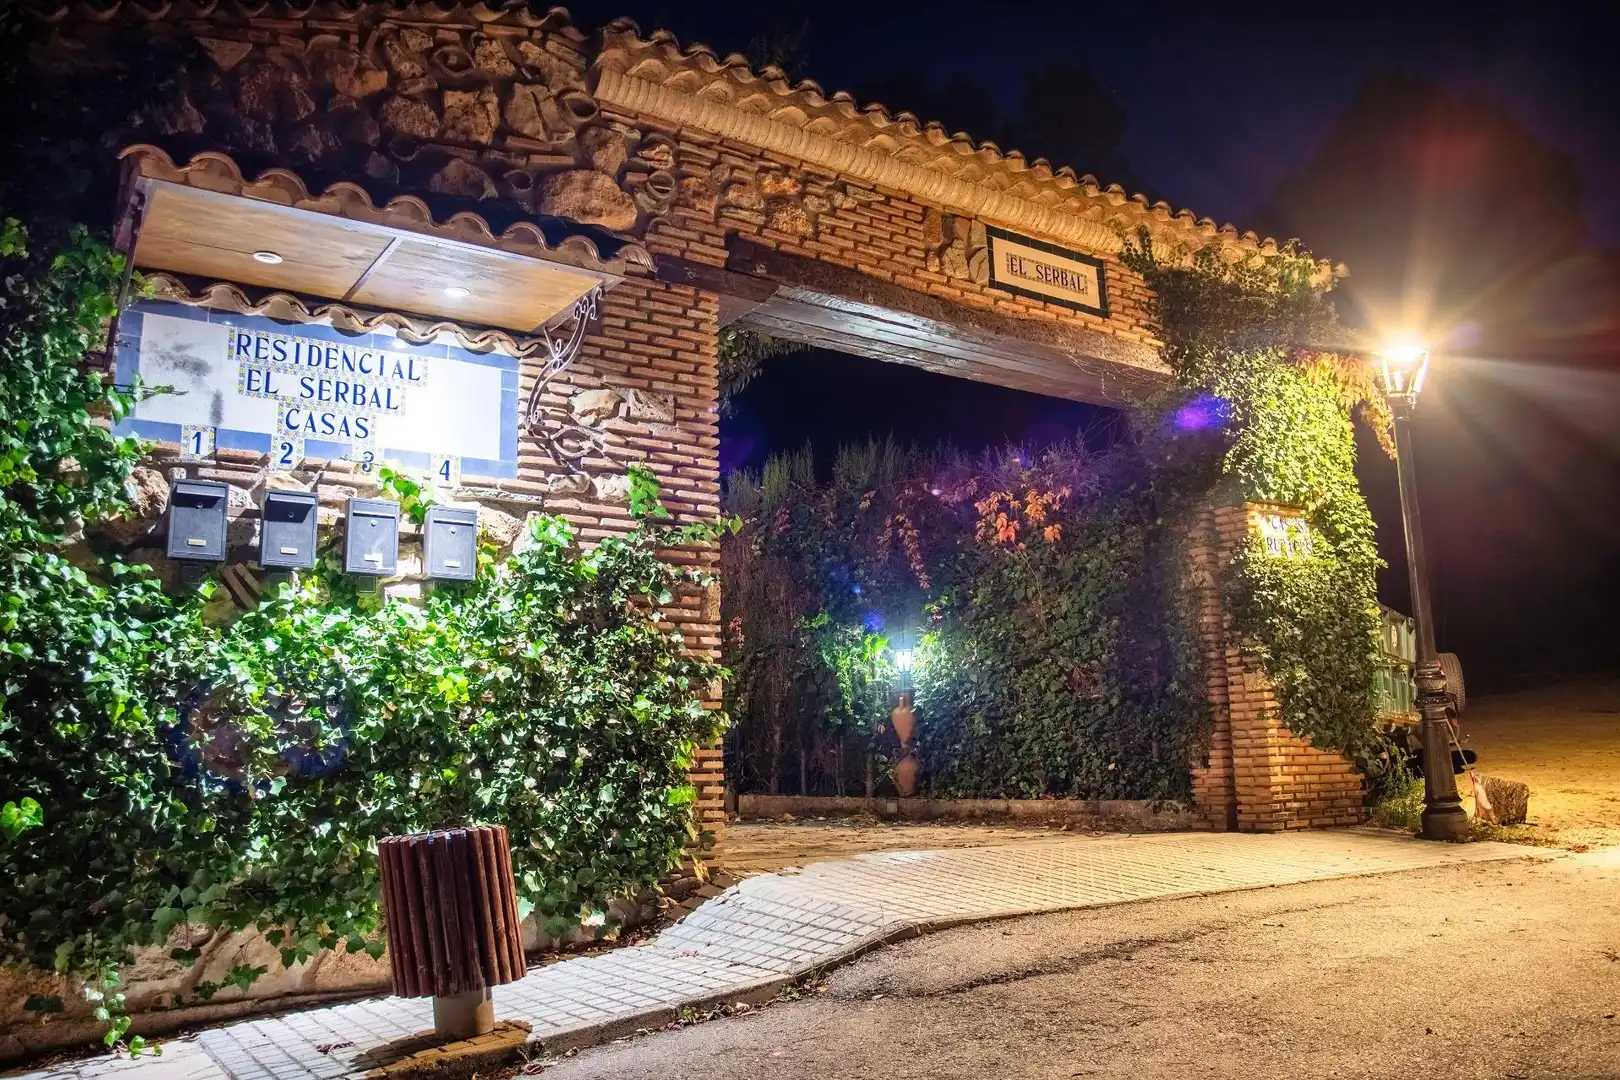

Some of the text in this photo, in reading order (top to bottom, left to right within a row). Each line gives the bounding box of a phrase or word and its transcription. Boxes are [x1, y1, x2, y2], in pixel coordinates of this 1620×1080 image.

[1010, 256, 1085, 291] EL SERBAL
[236, 333, 420, 381] RESIDENCIAL
[246, 369, 399, 410] EL SERBAL
[285, 408, 369, 439] CASAS
[192, 431, 201, 455] 1
[280, 442, 293, 464] 2
[362, 451, 374, 472] 3
[439, 460, 450, 481] 4
